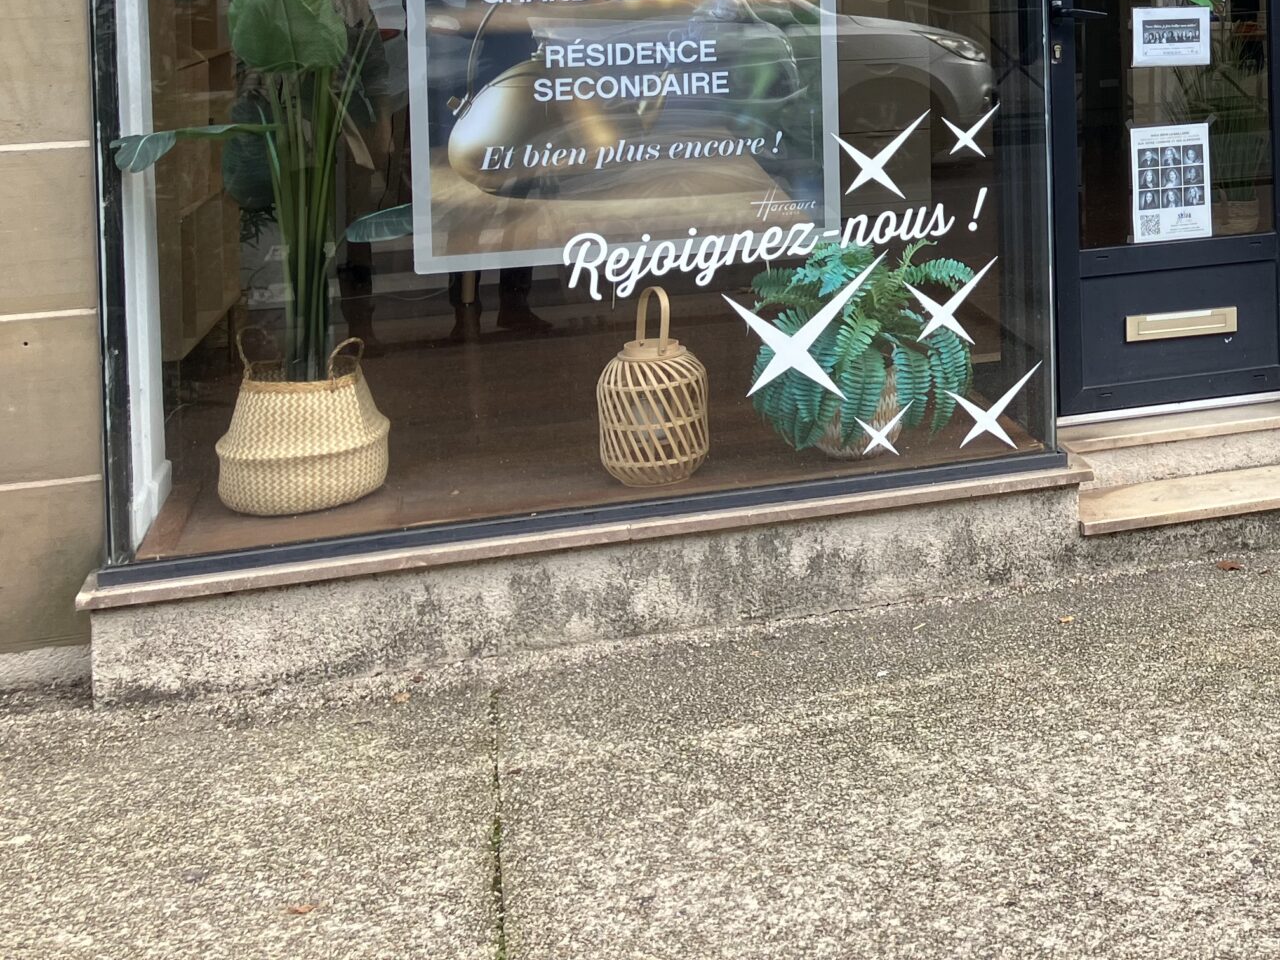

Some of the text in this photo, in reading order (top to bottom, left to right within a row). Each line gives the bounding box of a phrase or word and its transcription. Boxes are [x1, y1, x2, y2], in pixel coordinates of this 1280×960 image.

[545, 39, 718, 69] RÉSIDENCE
[533, 71, 730, 103] SECONDAIRE
[480, 130, 784, 171] Et bien plus encore !
[750, 184, 816, 222] Harcourt
[562, 187, 989, 301] Rejoignez-nous !
